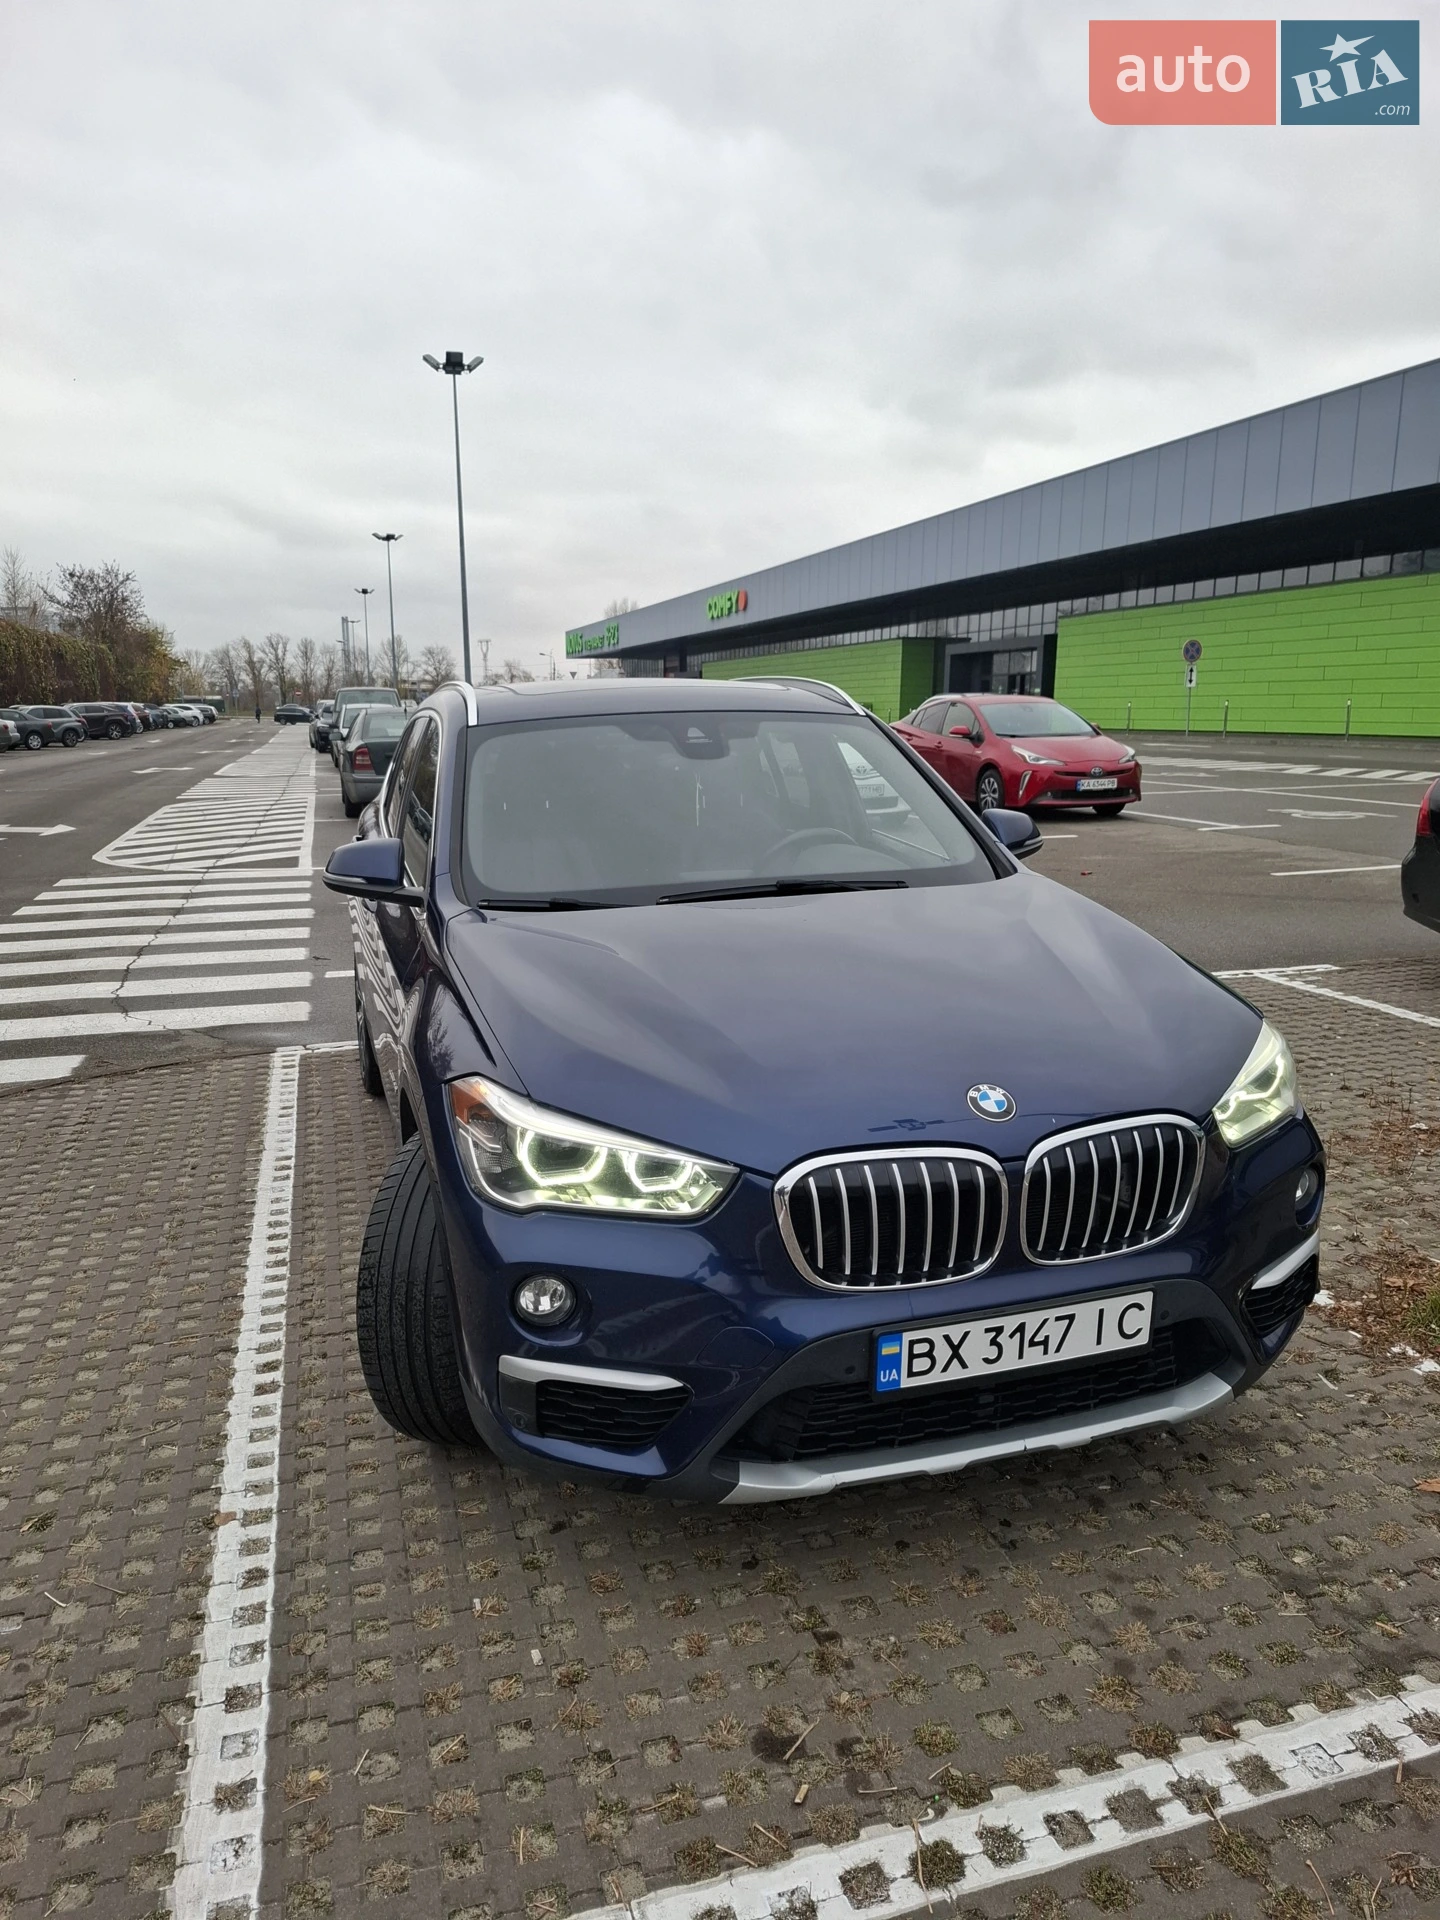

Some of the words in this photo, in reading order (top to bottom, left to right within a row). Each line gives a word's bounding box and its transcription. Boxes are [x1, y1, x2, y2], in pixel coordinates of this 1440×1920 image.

[706, 590, 738, 620] COMFY
[906, 1330, 971, 1378] BX
[981, 1313, 1076, 1365] 3147
[1096, 1302, 1146, 1346] IC
[880, 1368, 899, 1382] UA
